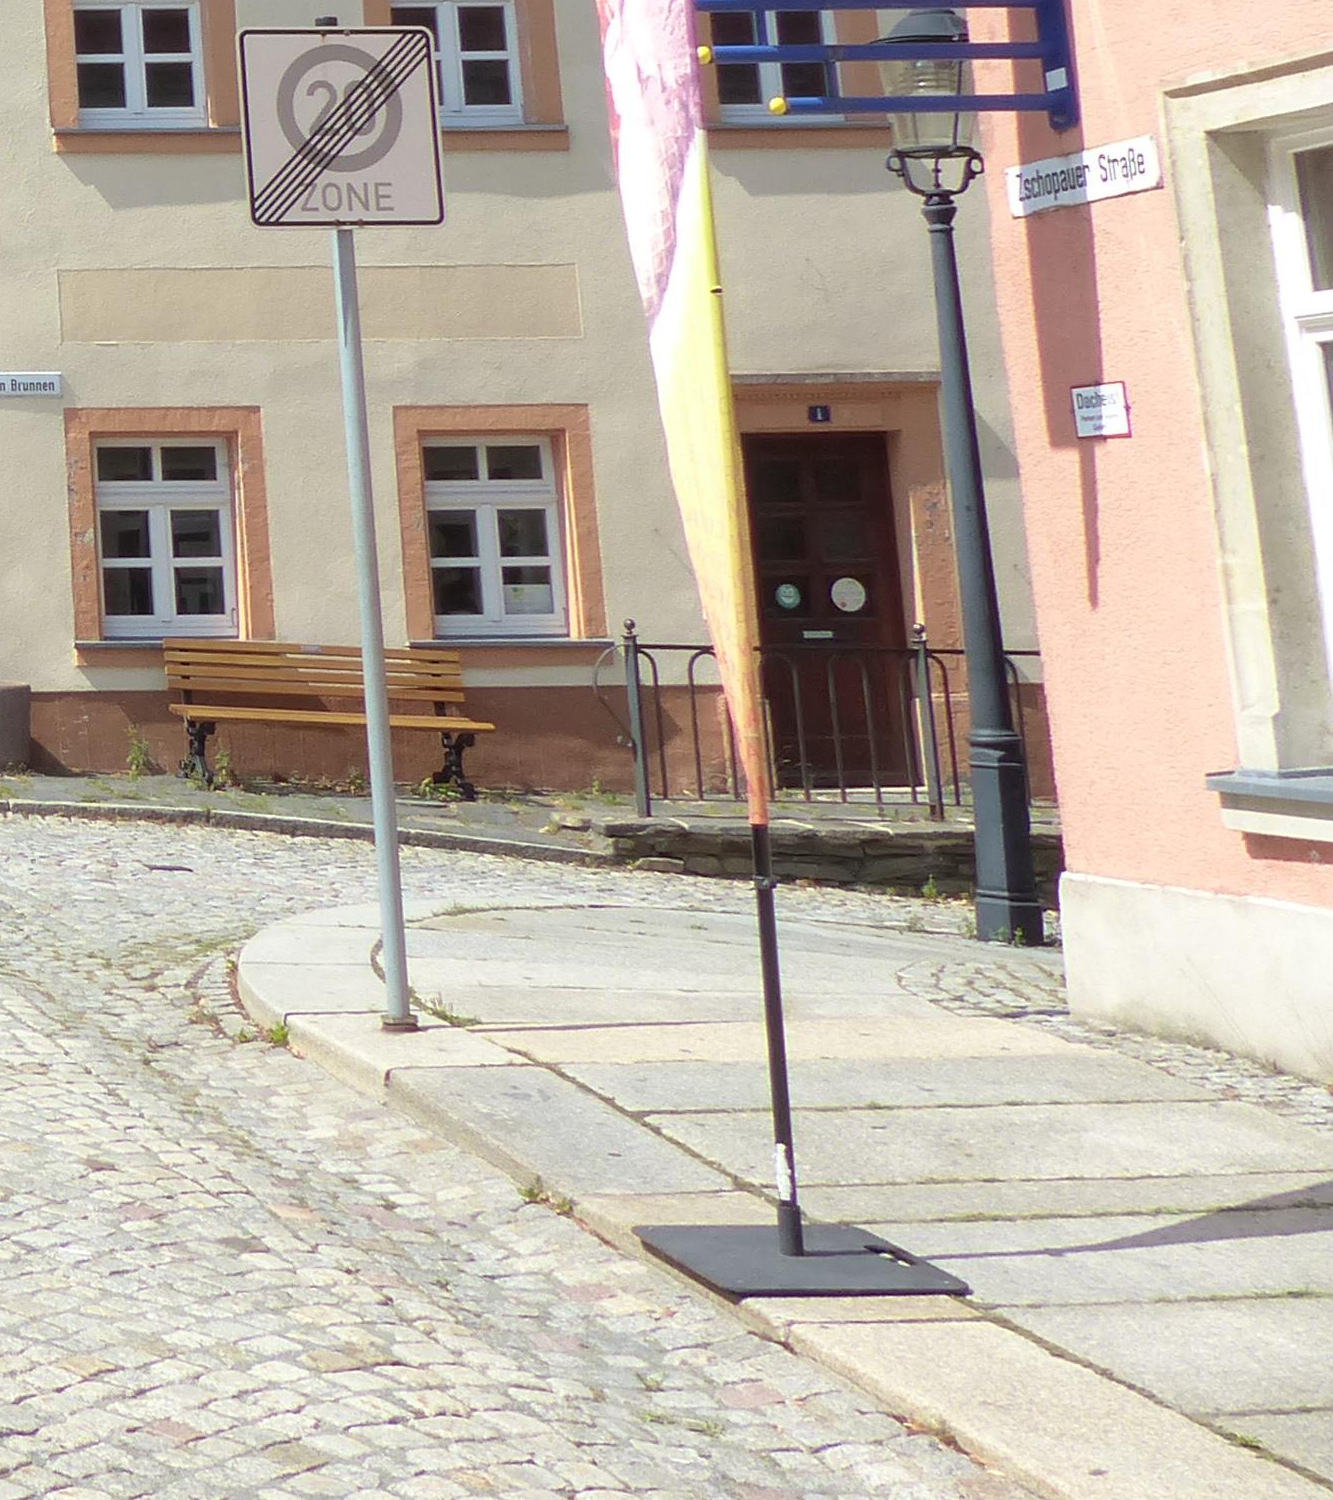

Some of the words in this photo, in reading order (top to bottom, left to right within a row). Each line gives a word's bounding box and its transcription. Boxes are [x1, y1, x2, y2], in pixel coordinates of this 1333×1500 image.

[306, 80, 377, 136] 20
[1016, 164, 1091, 202] Zschopauer
[1098, 148, 1146, 184] Straße
[300, 182, 395, 212] ZONE
[11, 378, 55, 392] Brunnen
